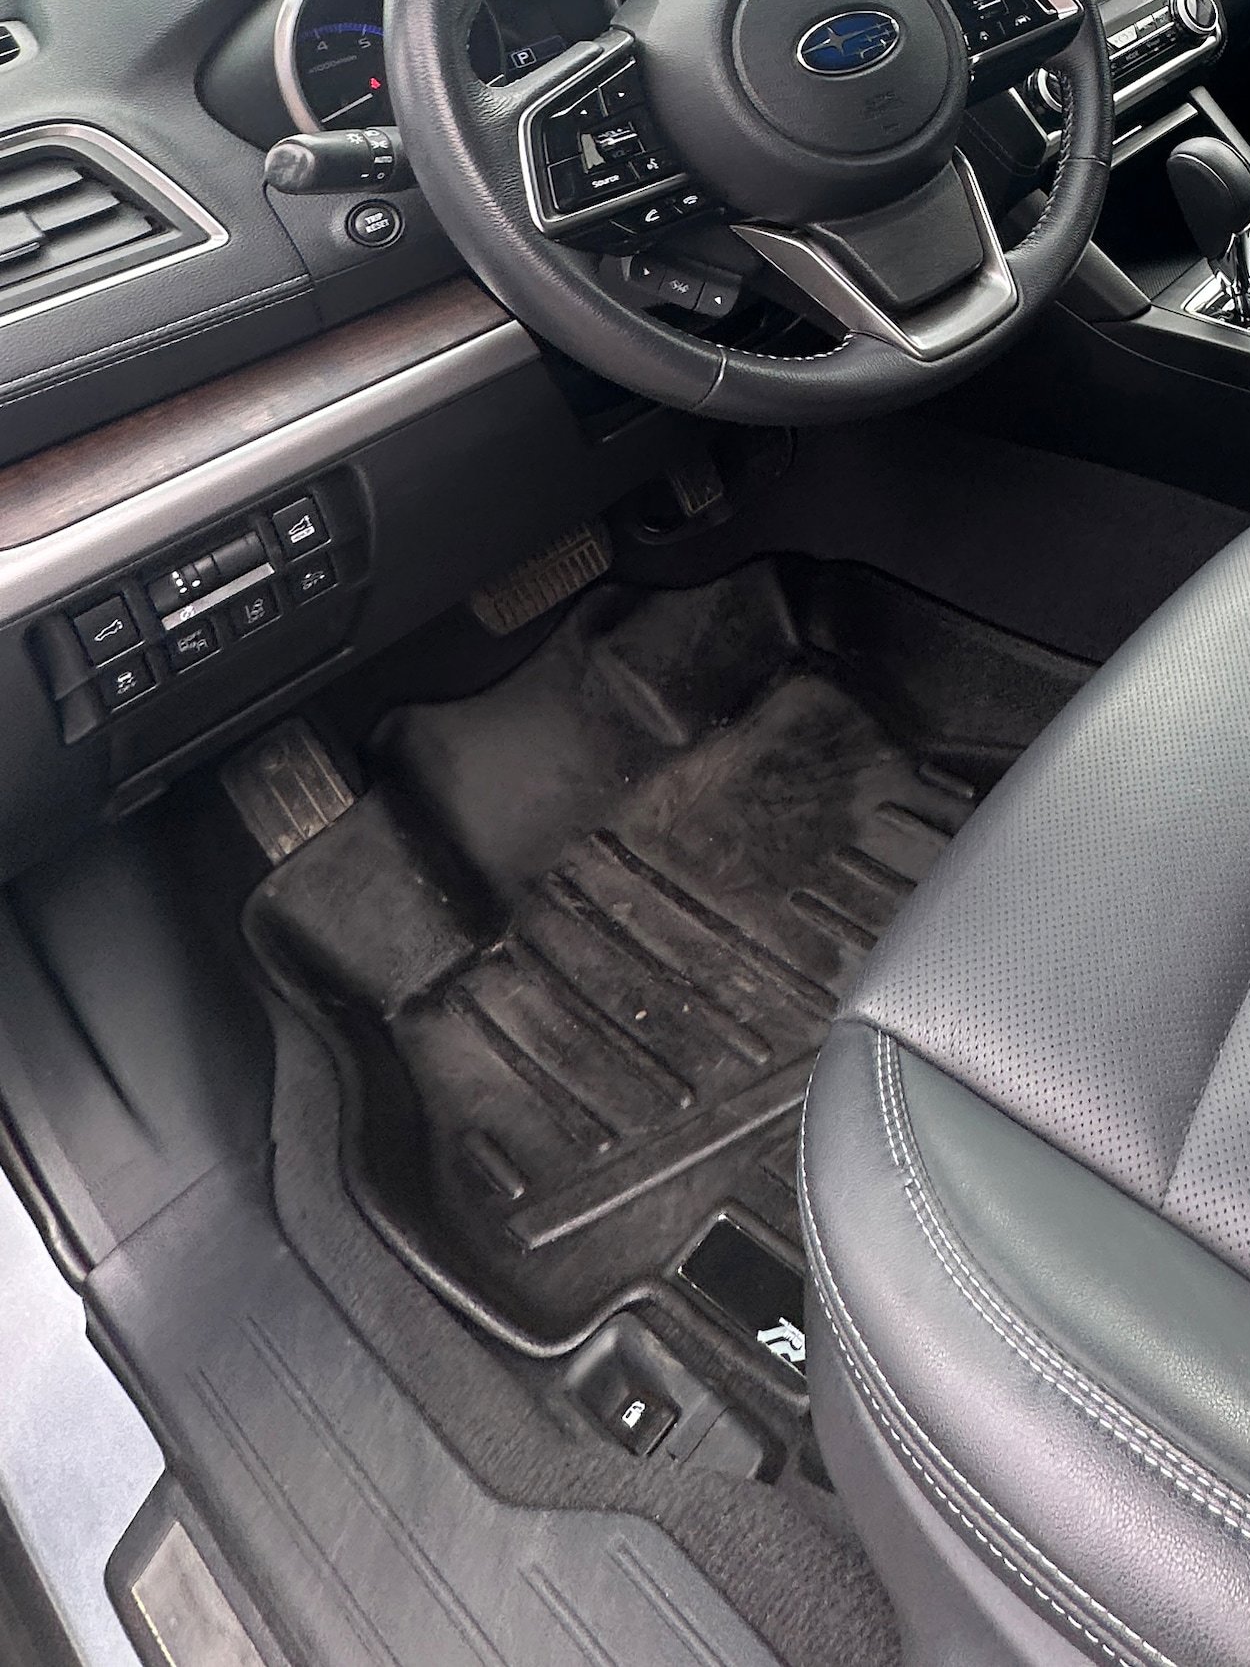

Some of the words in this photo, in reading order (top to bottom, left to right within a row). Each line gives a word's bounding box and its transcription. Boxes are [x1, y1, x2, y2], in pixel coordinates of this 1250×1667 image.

[317, 40, 329, 51] 4
[358, 37, 372, 49] 5
[517, 51, 530, 65] P
[591, 174, 620, 189] Source
[365, 212, 384, 225] TRIP
[365, 218, 390, 234] RESET
